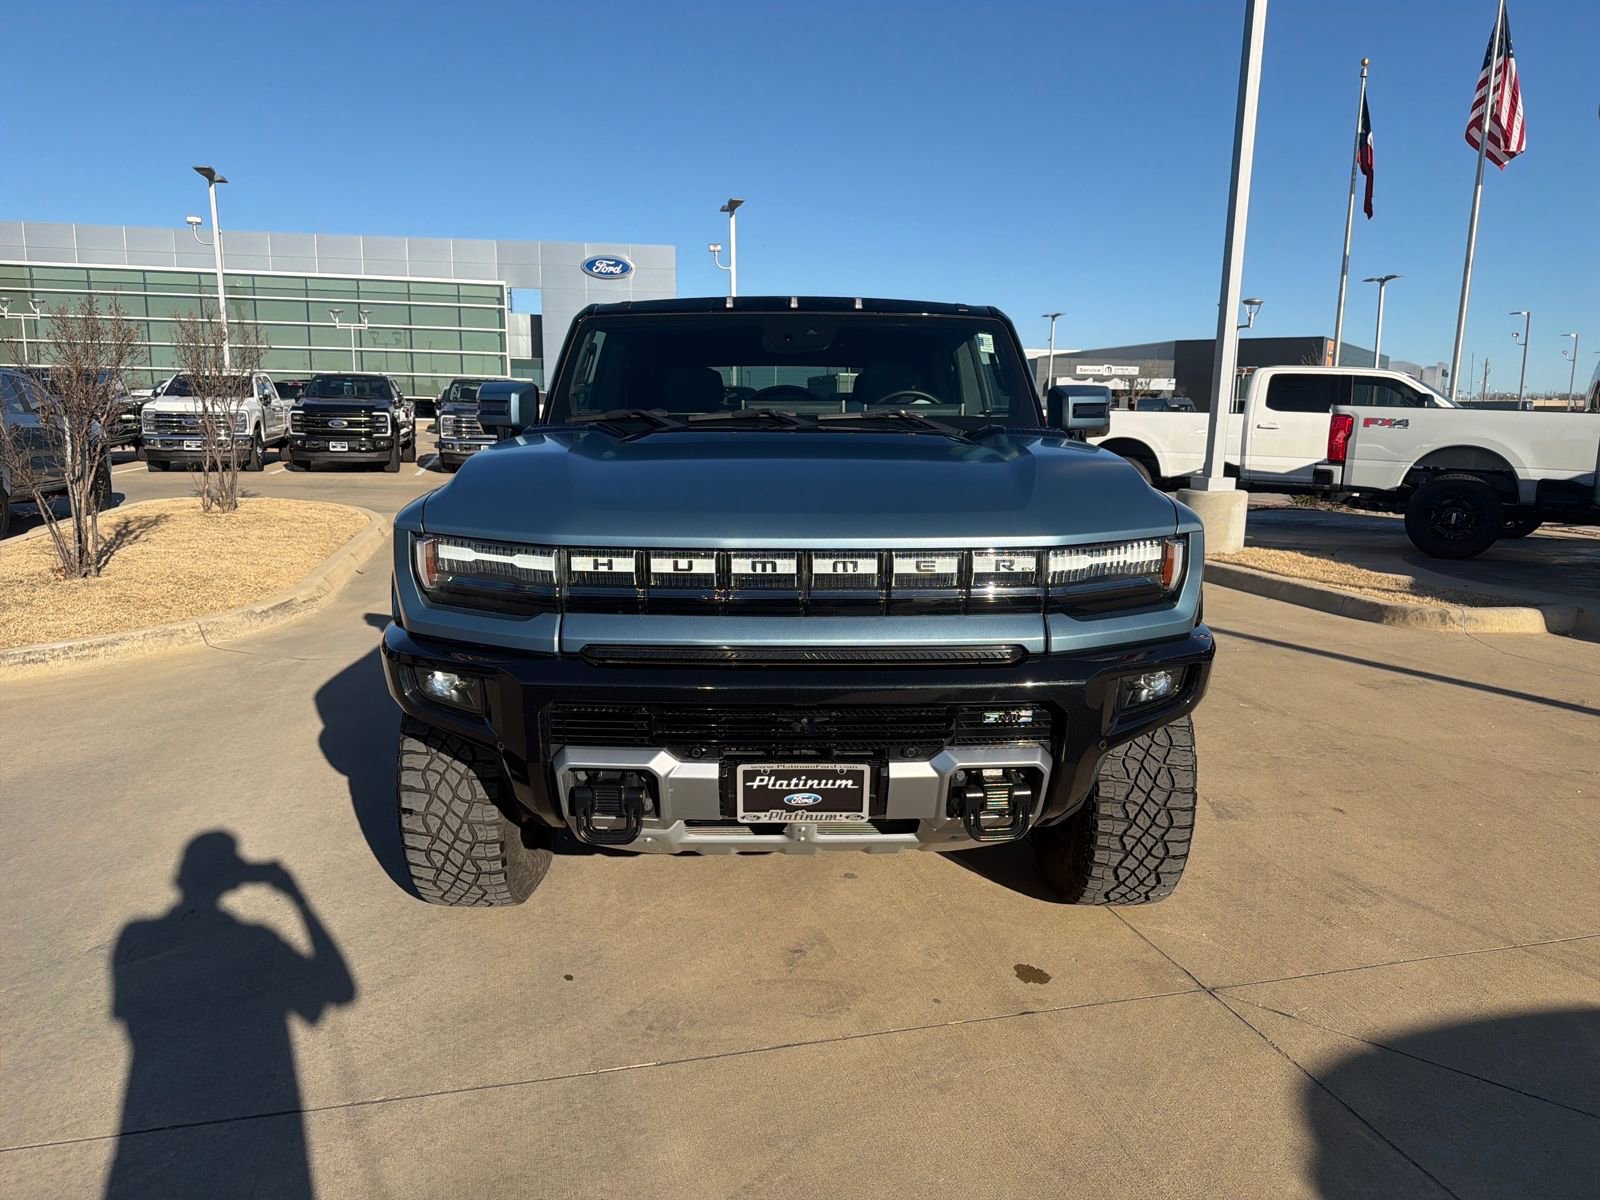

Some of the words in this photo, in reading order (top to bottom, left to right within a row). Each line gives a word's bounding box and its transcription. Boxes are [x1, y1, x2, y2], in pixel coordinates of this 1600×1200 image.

[1363, 417, 1409, 428] FX4
[745, 775, 859, 790] Platinum
[767, 811, 838, 821] Platinum
